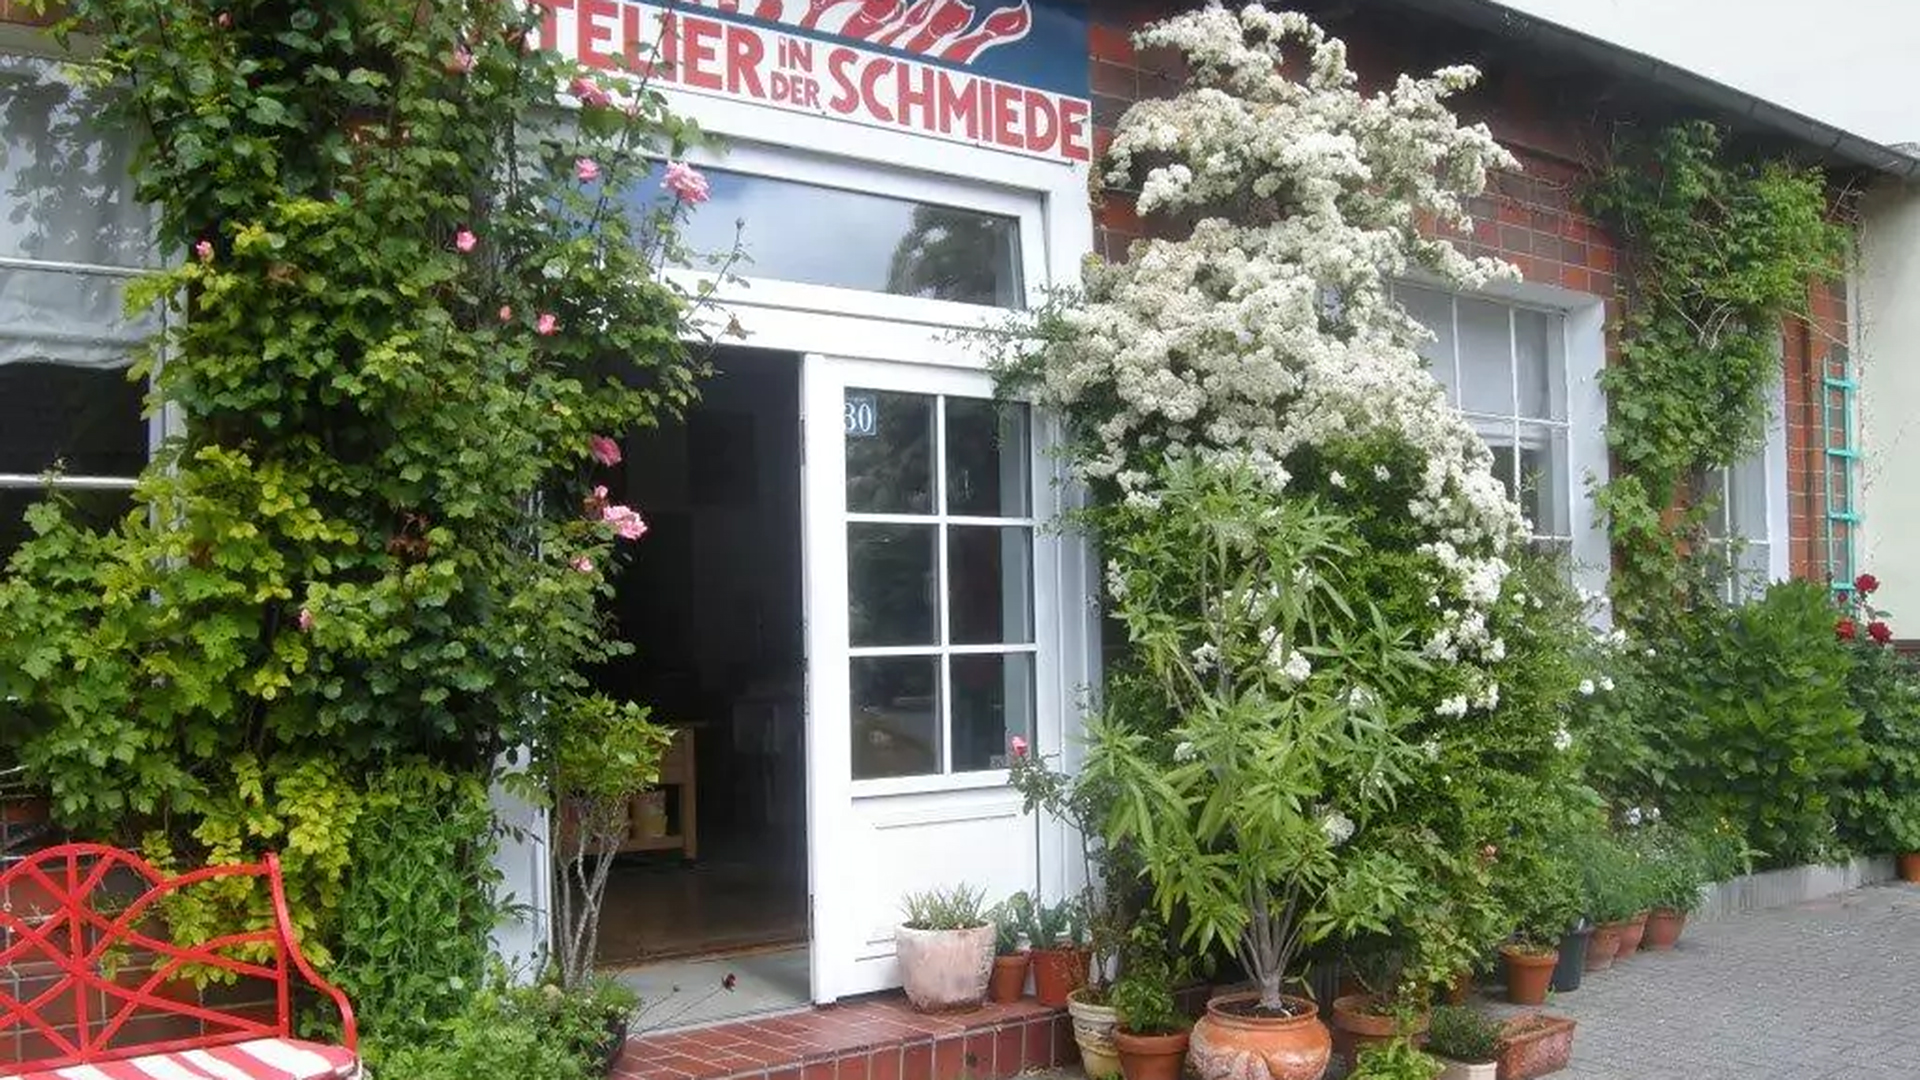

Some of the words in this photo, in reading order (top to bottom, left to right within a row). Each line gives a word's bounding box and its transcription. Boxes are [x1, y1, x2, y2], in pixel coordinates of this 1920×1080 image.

[522, 0, 767, 99] TELIER
[770, 71, 821, 110] DER
[828, 47, 1090, 161] SCHMIEDE
